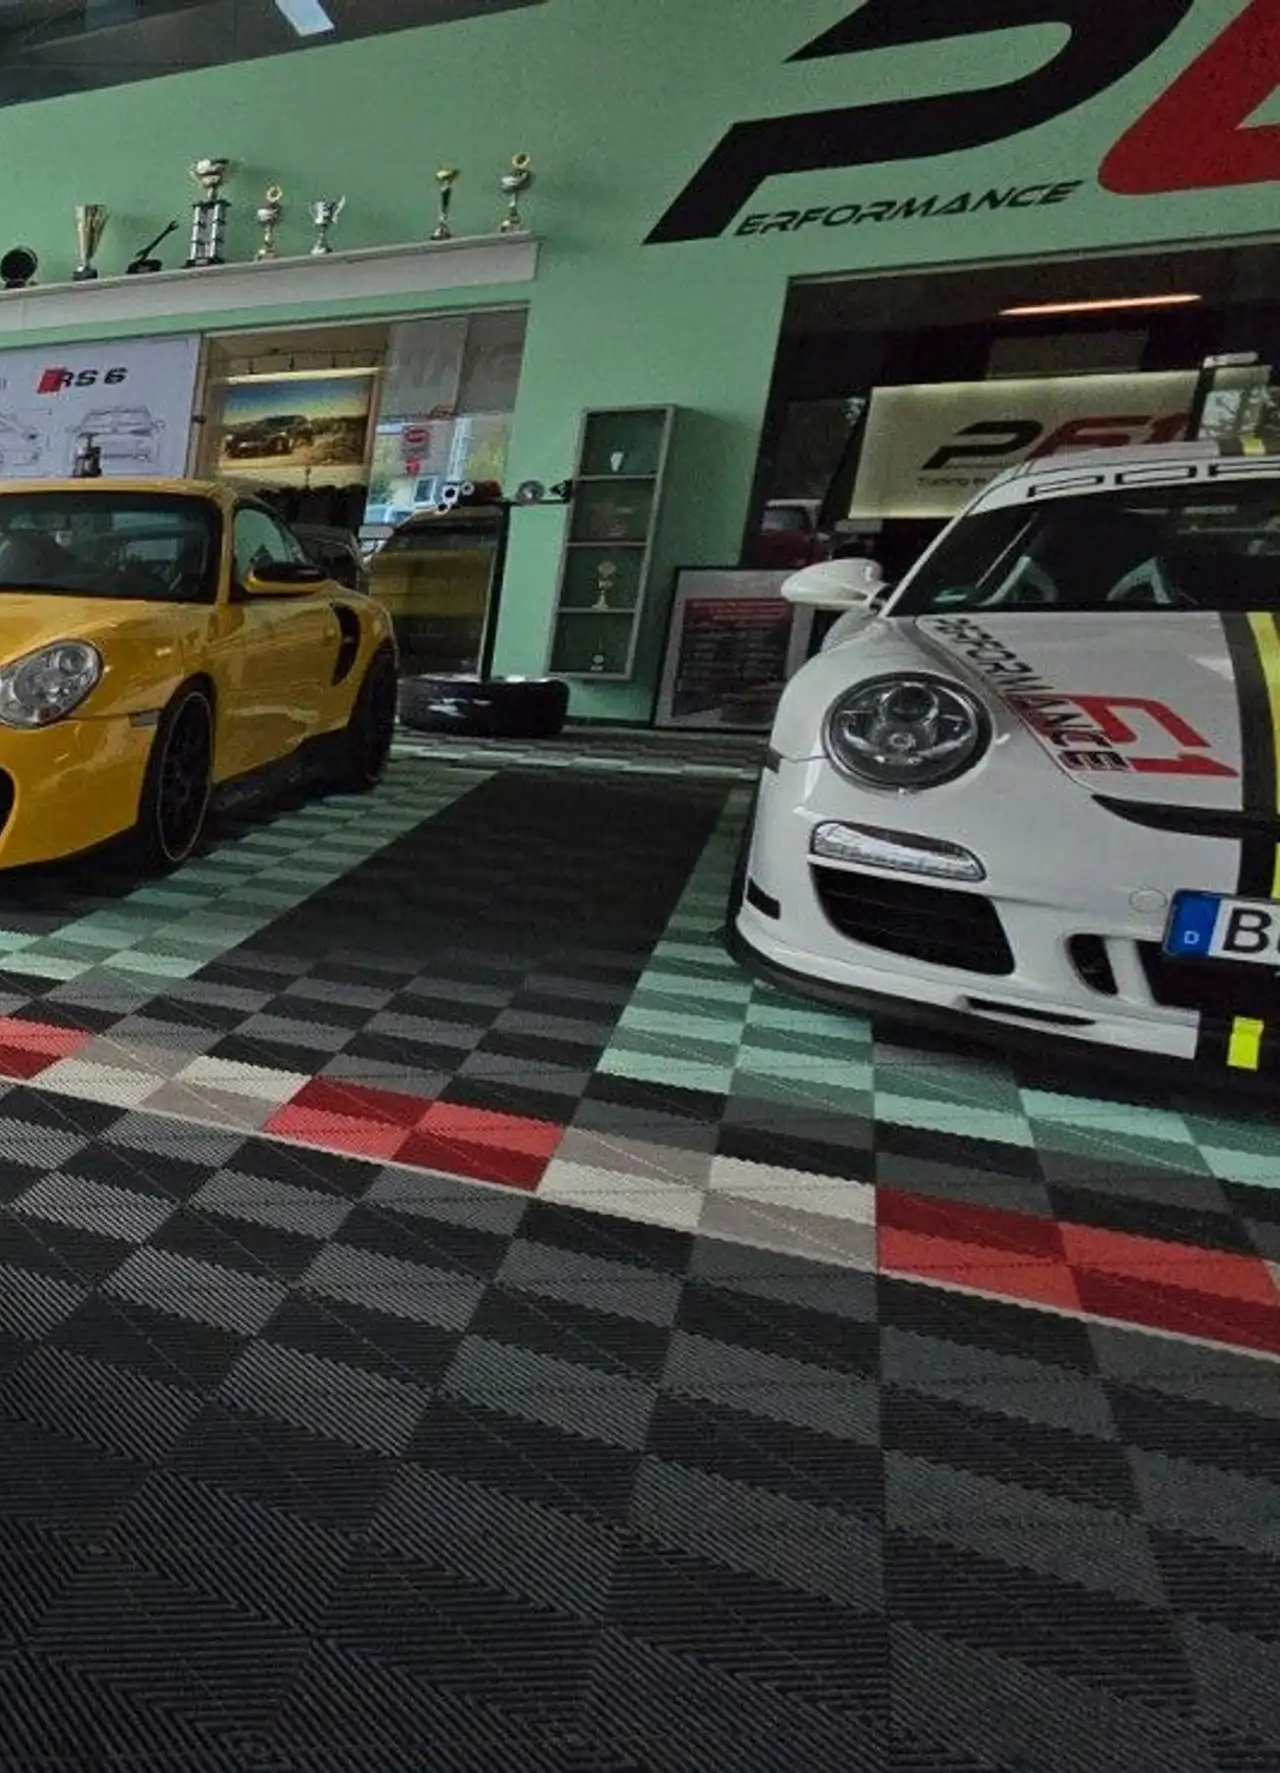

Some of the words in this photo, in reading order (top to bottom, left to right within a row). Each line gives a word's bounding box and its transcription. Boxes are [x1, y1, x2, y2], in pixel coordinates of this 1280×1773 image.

[736, 180, 1086, 237] ERFORMANCE
[1183, 930, 1201, 945] D
[1221, 906, 1280, 954] B
